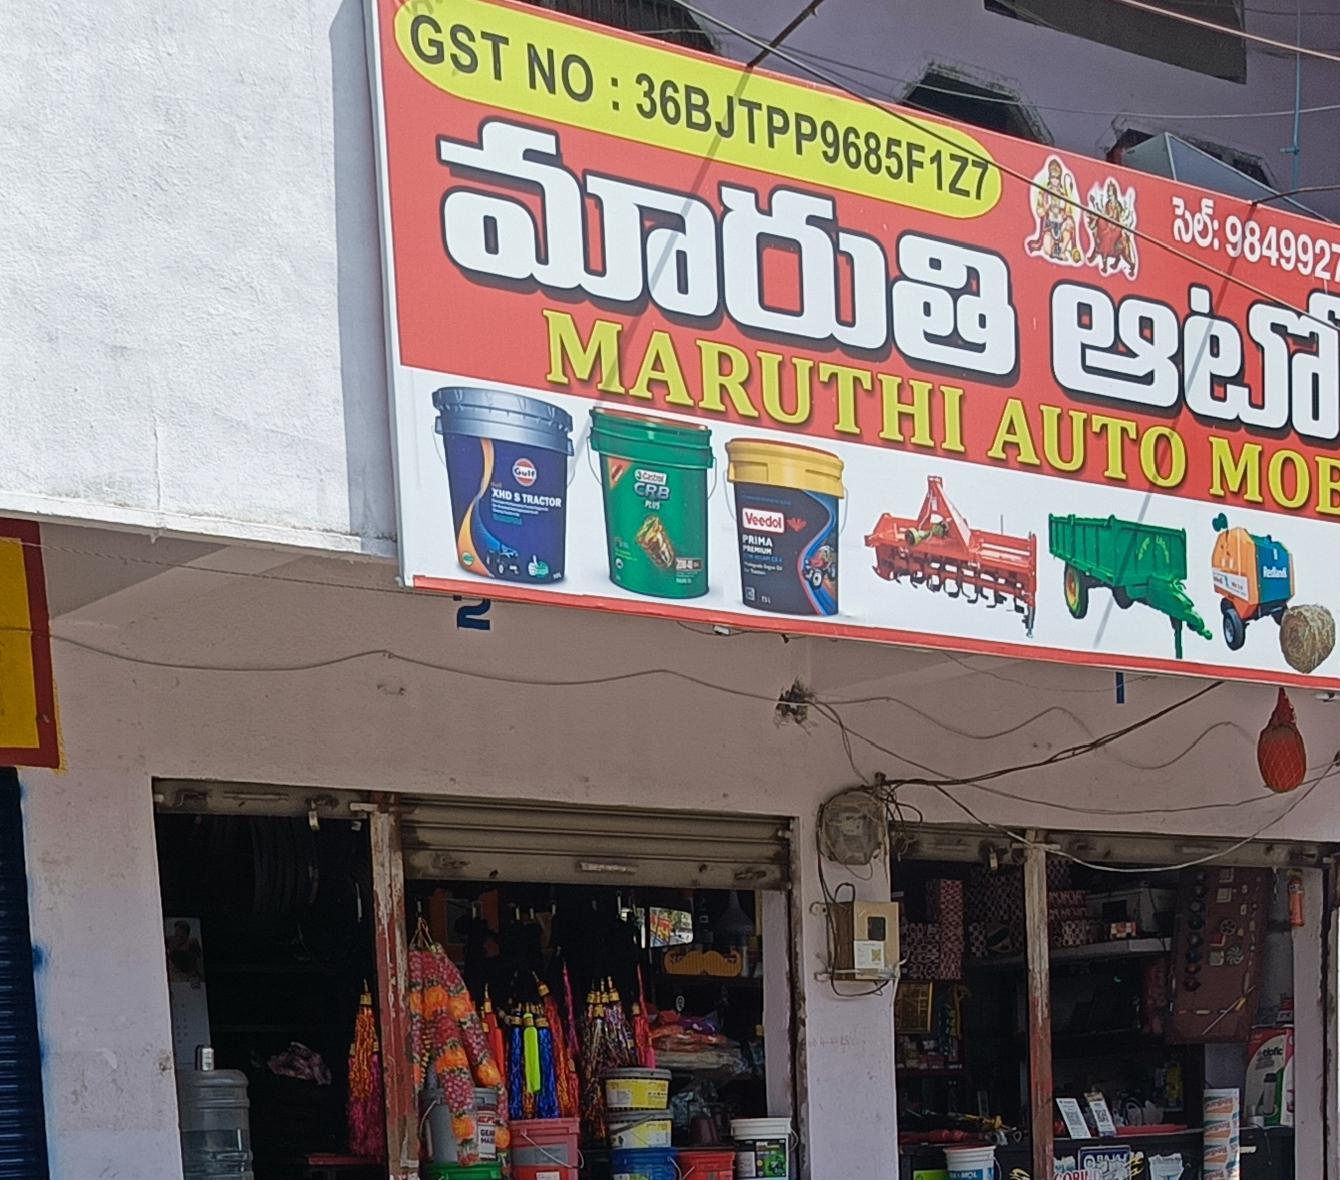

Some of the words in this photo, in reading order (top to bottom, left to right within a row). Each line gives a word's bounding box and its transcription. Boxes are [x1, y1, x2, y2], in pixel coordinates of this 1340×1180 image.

[409, 13, 510, 82] GST
[527, 42, 594, 102] NO
[635, 72, 991, 201] 36BJTPP9685F1Z7
[438, 120, 1020, 379] మారుతి
[542, 307, 968, 454] MARUTHI
[986, 396, 1189, 491] AUTO
[514, 466, 536, 479] Gulf
[521, 493, 562, 508] TRACTOR
[634, 482, 671, 501] CRB
[744, 511, 782, 530] Veedol
[742, 533, 774, 547] PRIMA
